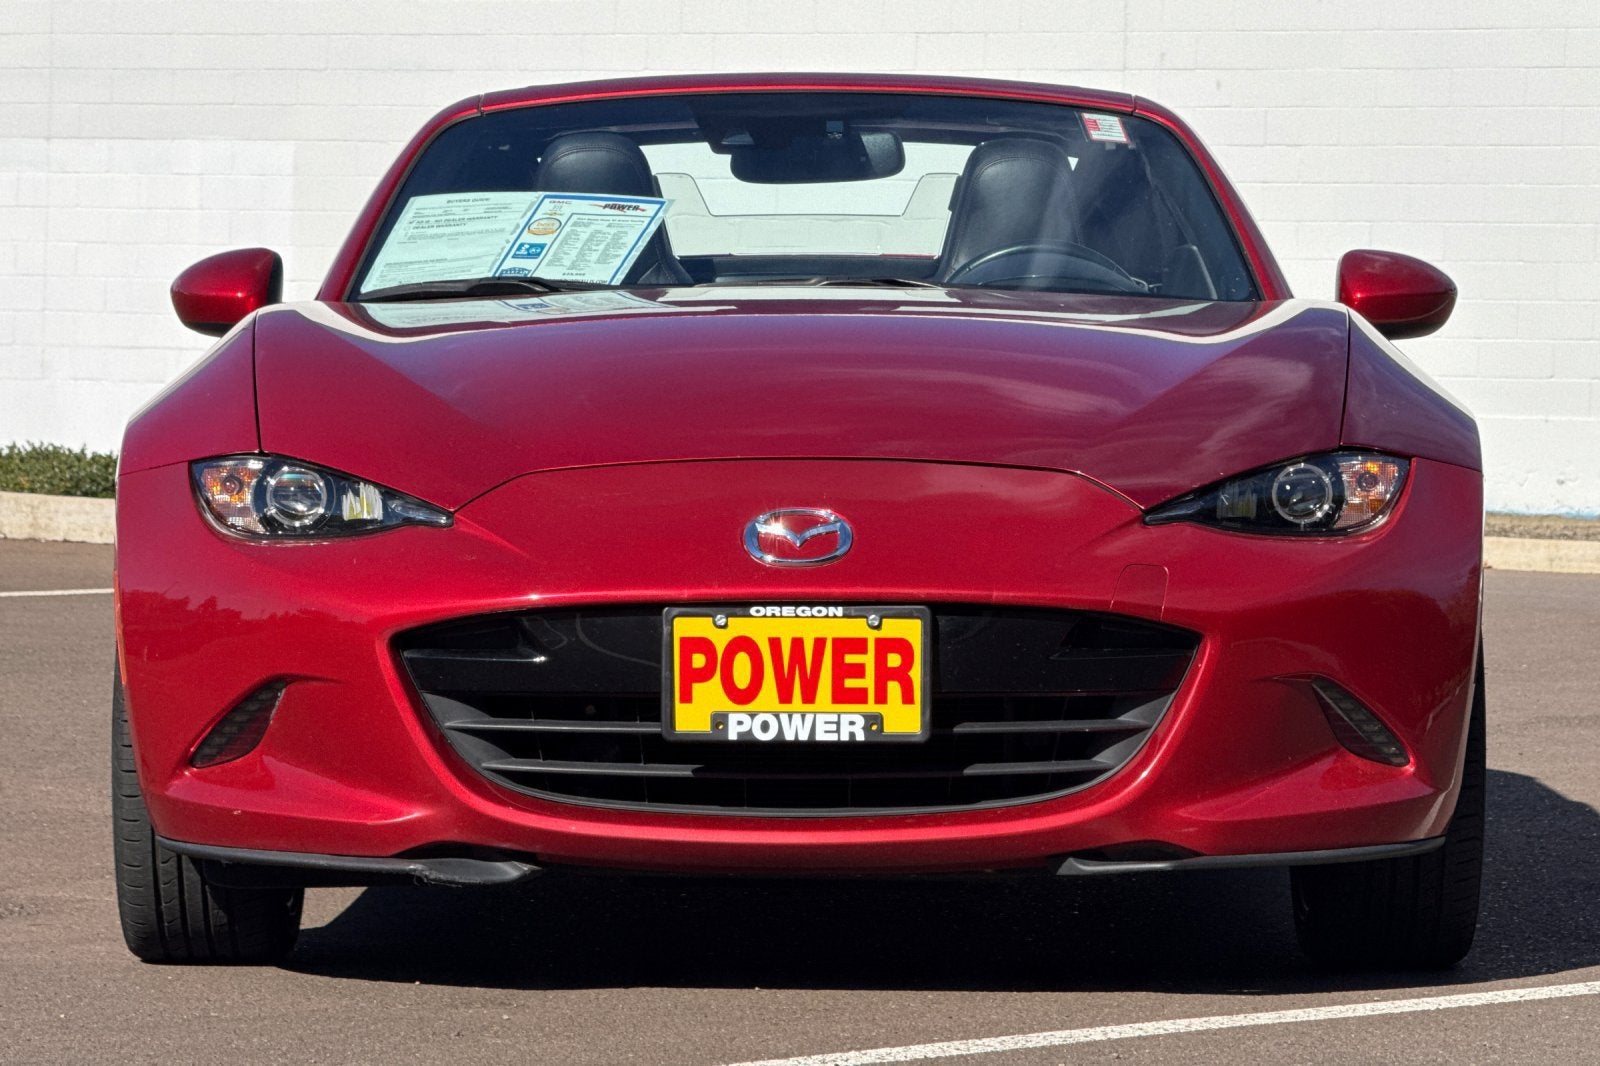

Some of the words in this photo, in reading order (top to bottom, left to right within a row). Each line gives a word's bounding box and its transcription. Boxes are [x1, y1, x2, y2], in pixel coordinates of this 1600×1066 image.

[749, 606, 844, 618] OREGON
[678, 635, 916, 706] POWER
[728, 713, 865, 742] POWER
